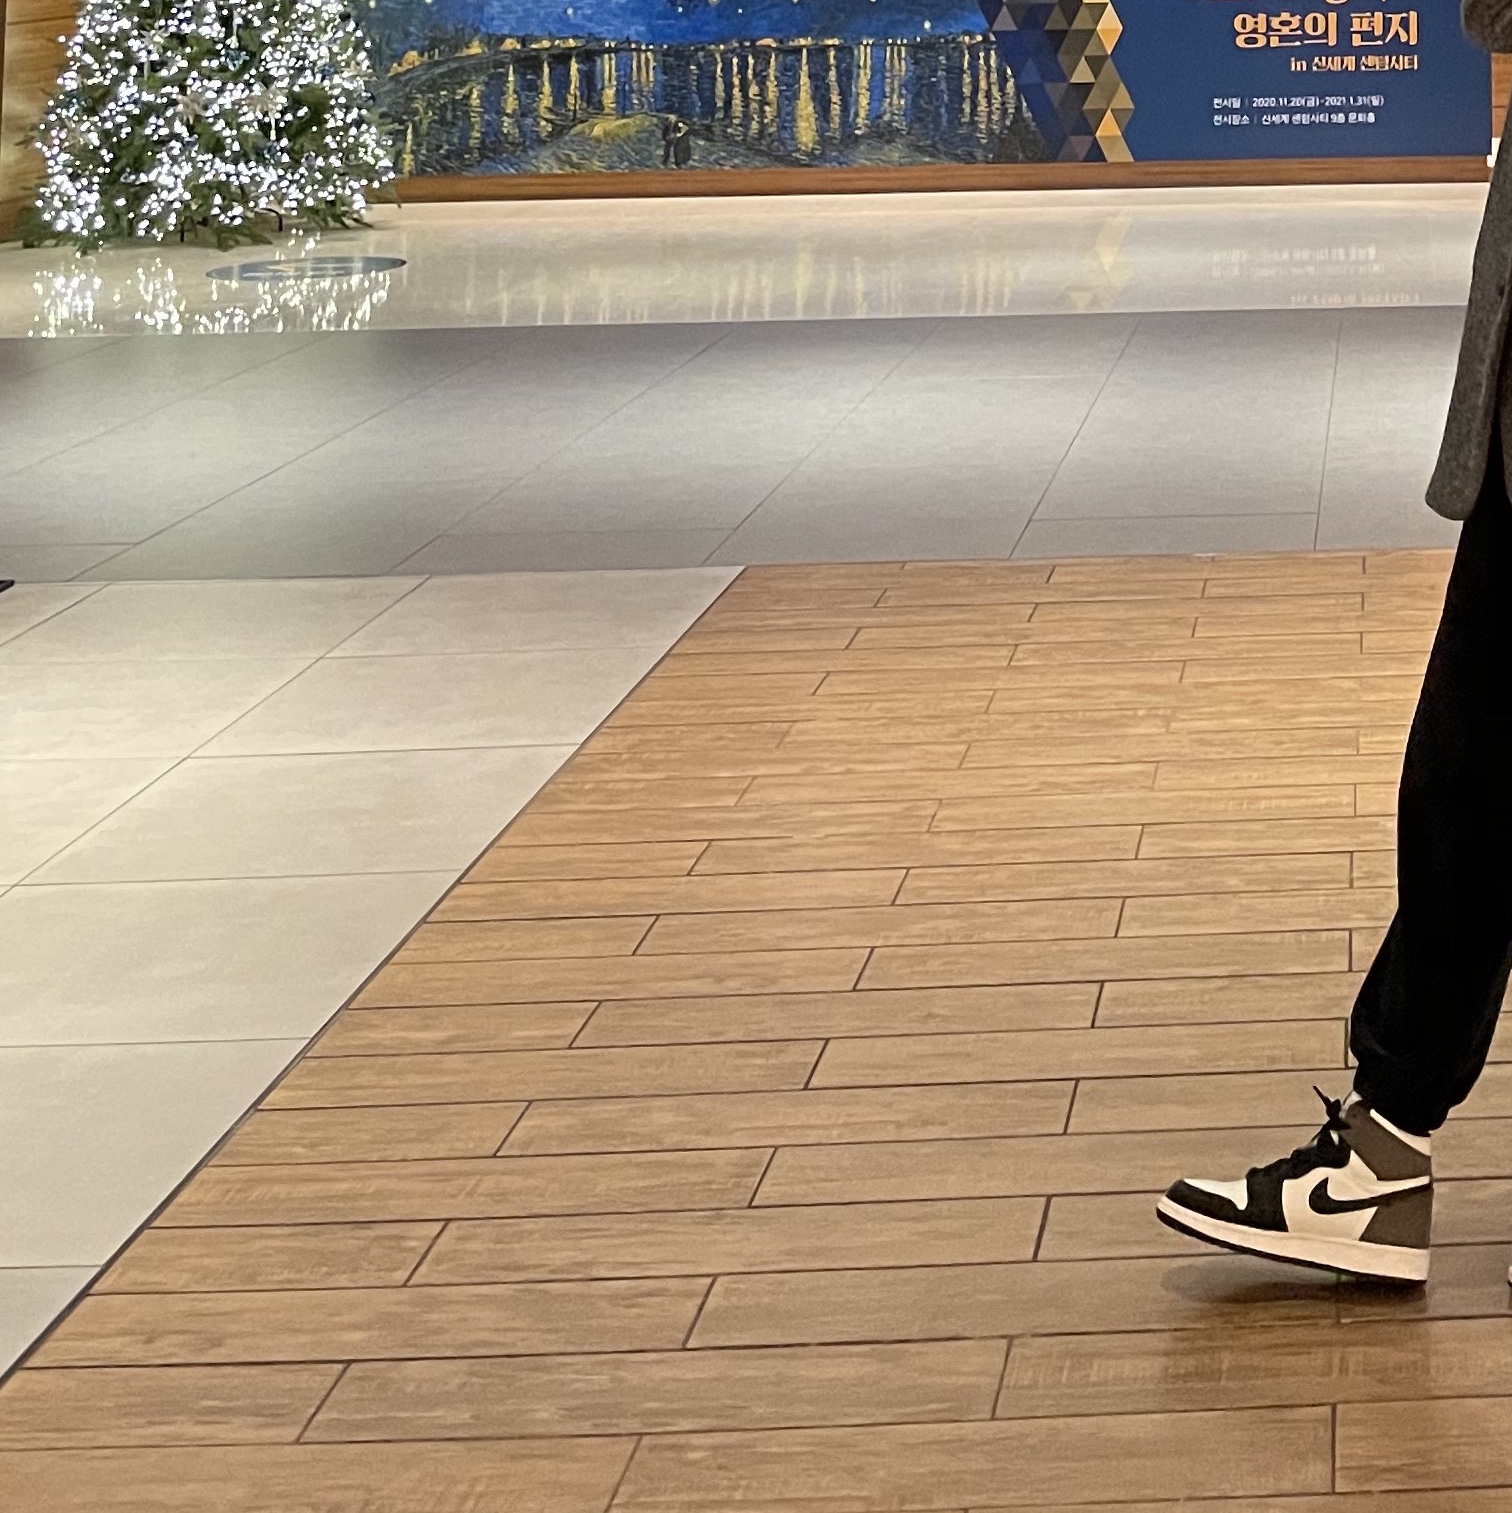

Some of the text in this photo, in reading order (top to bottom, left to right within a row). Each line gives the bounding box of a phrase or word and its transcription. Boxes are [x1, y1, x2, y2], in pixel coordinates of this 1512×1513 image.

[1233, 11, 1419, 49] 영혼의 편지
[1290, 57, 1307, 72] in
[1312, 56, 1356, 72] 신세계
